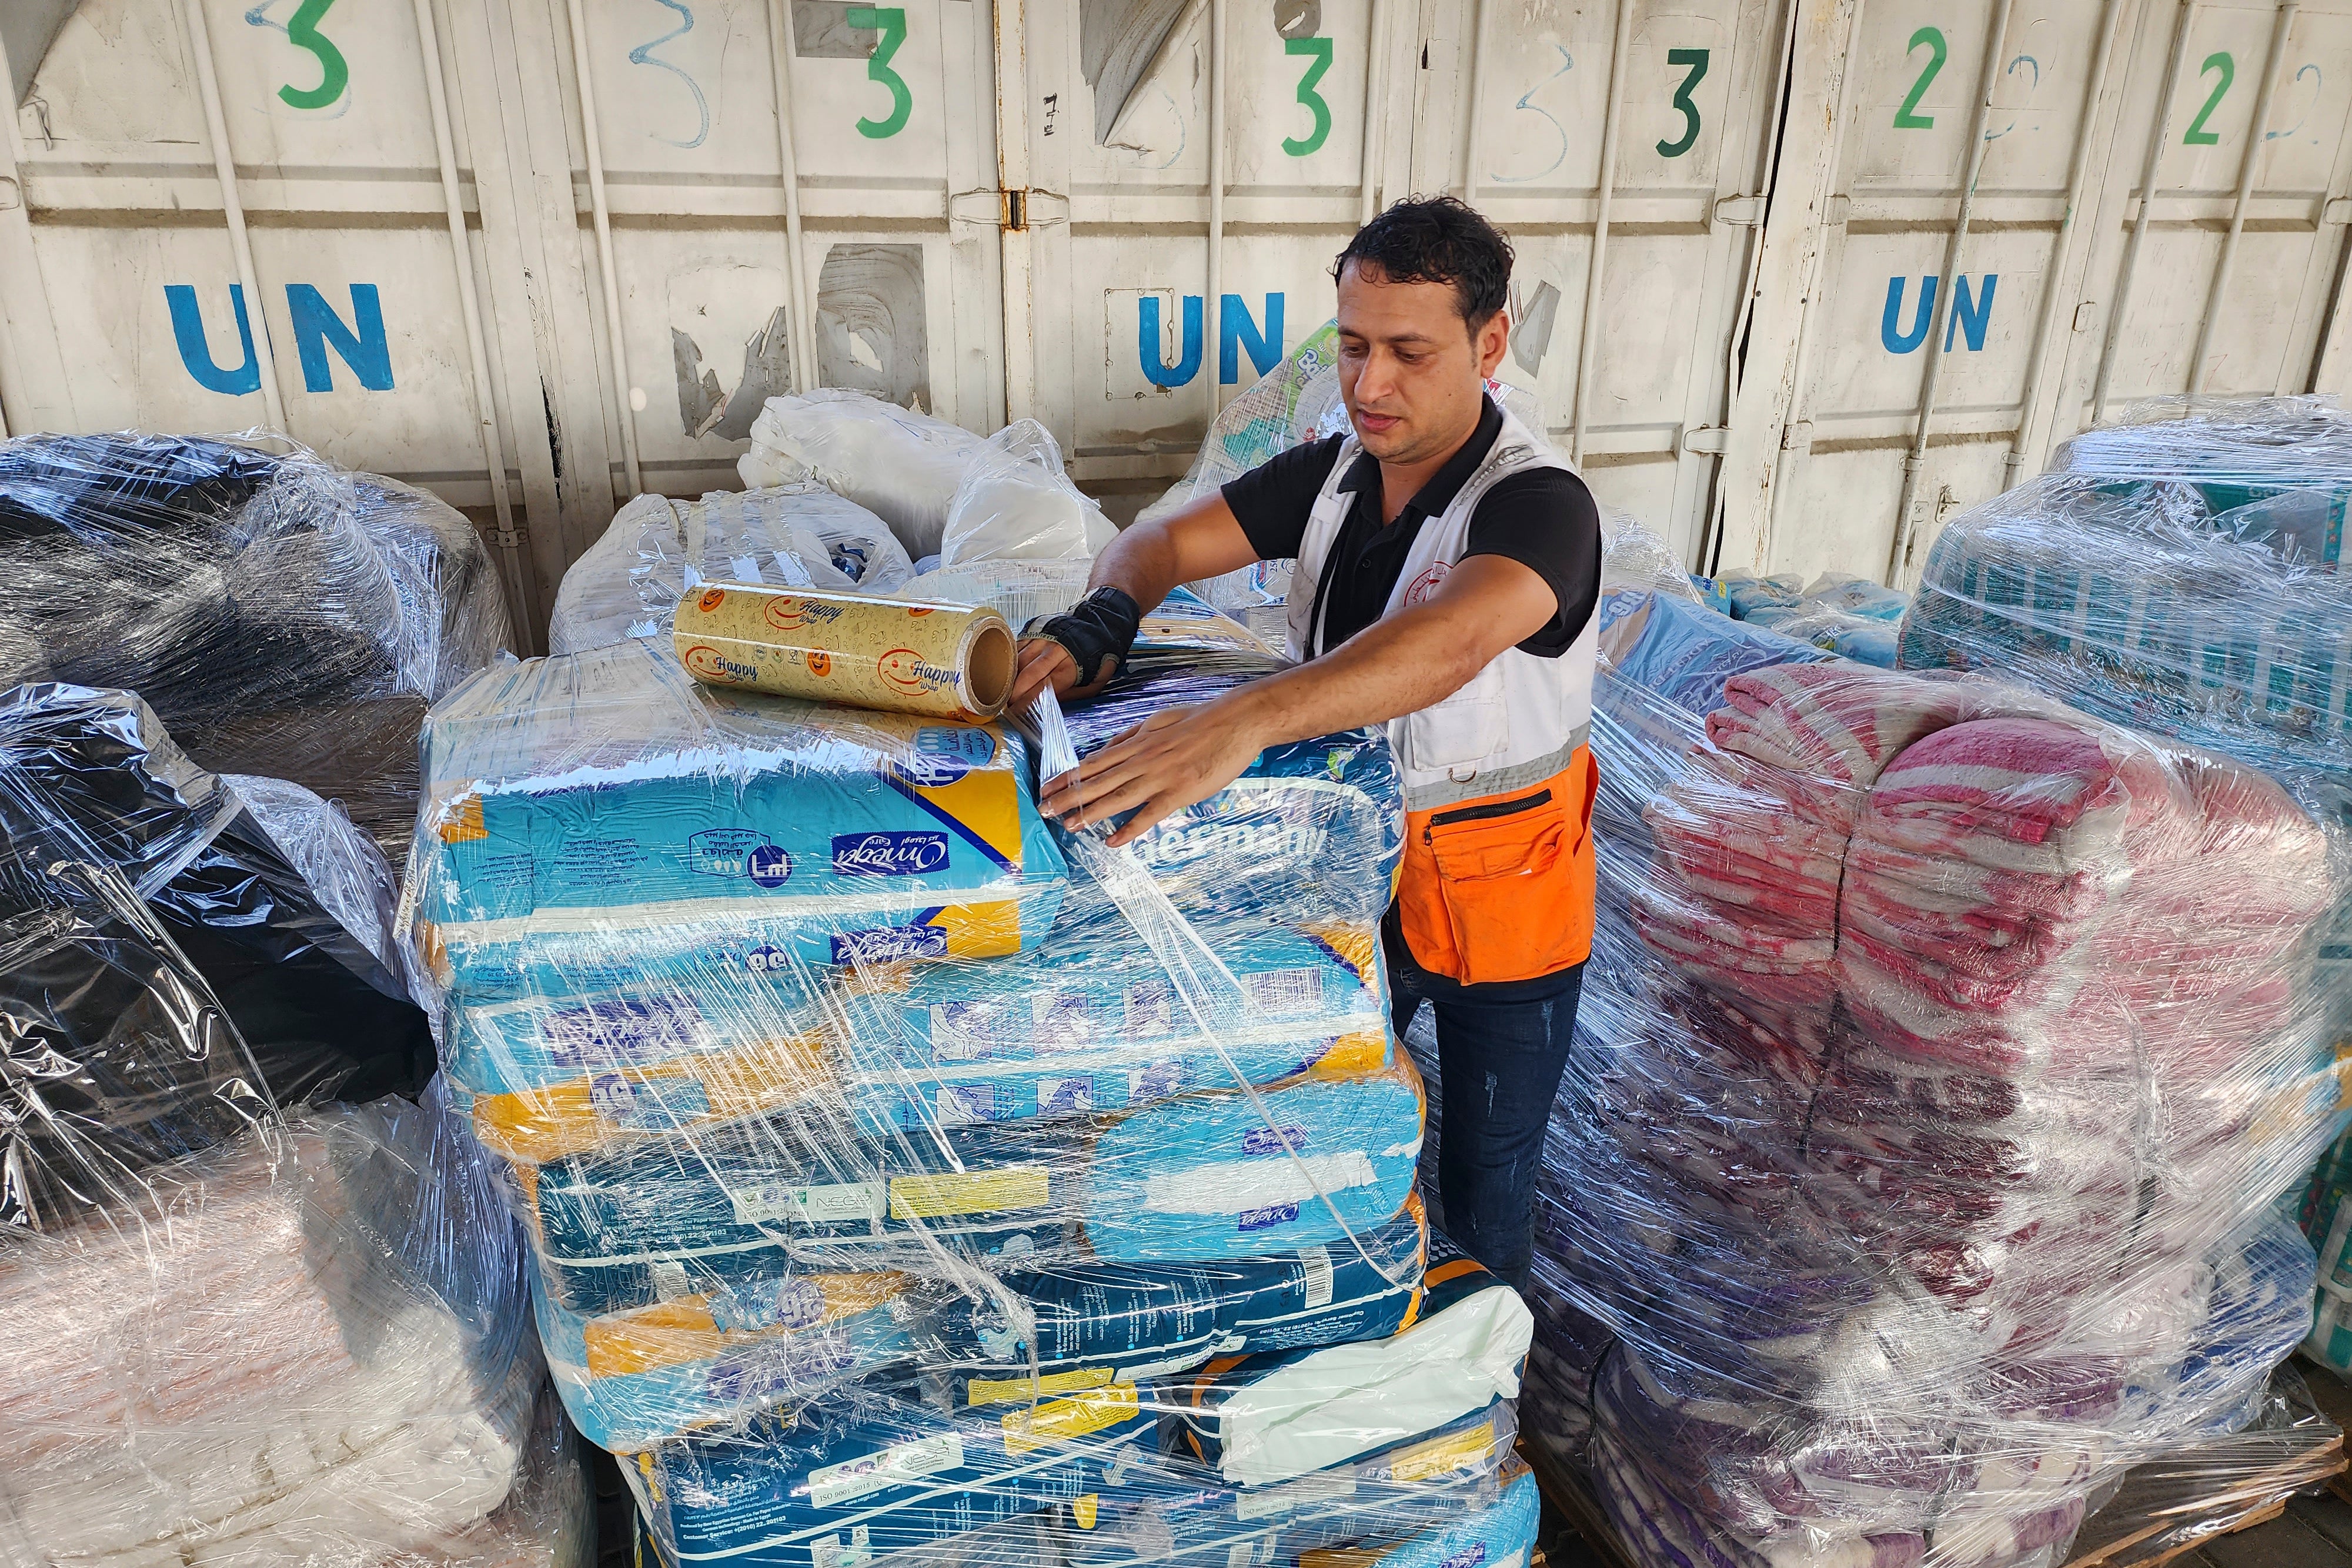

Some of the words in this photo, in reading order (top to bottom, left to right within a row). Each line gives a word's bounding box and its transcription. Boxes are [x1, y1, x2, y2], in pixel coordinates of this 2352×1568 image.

[278, 0, 349, 109] 3
[847, 8, 913, 139] 3
[1893, 27, 1947, 129] 2
[1281, 38, 1333, 156] 3
[1656, 49, 1710, 158] 3
[2183, 52, 2234, 145] 2
[1882, 274, 1998, 354] UN
[164, 283, 395, 396] UN
[1139, 292, 1285, 387] UN
[798, 614, 818, 625] Wrap
[799, 600, 844, 624] Happy
[715, 657, 759, 682] Happy
[726, 673, 745, 682] Wrap
[913, 659, 961, 691] Happy
[919, 681, 939, 693] Wrap
[701, 847, 743, 859] حفاضة
[836, 831, 946, 872] Omega
[750, 953, 786, 971] 36
[818, 1492, 833, 1501] ISO
[683, 1532, 709, 1540] Customer
[709, 1527, 733, 1538] Service:
[733, 1523, 756, 1534] +(2010)
